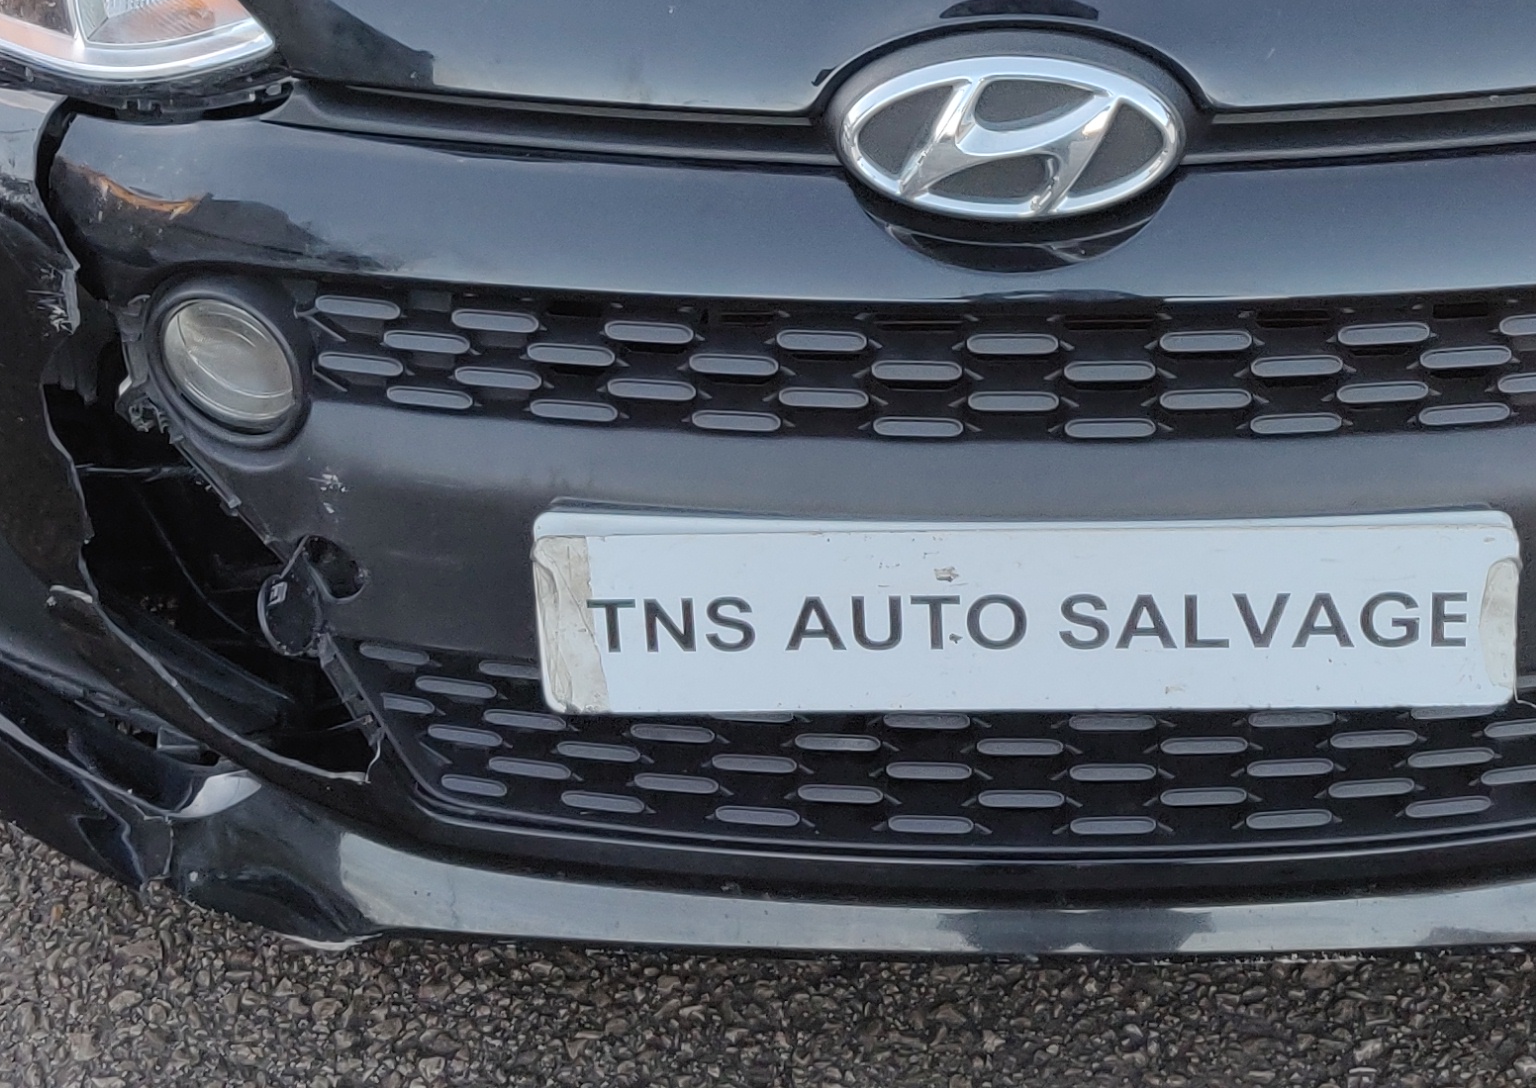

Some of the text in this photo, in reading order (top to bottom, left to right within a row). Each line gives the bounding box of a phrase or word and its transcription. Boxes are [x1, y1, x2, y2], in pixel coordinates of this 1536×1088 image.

[586, 591, 1468, 653] TNS AUTO SALVAGE
